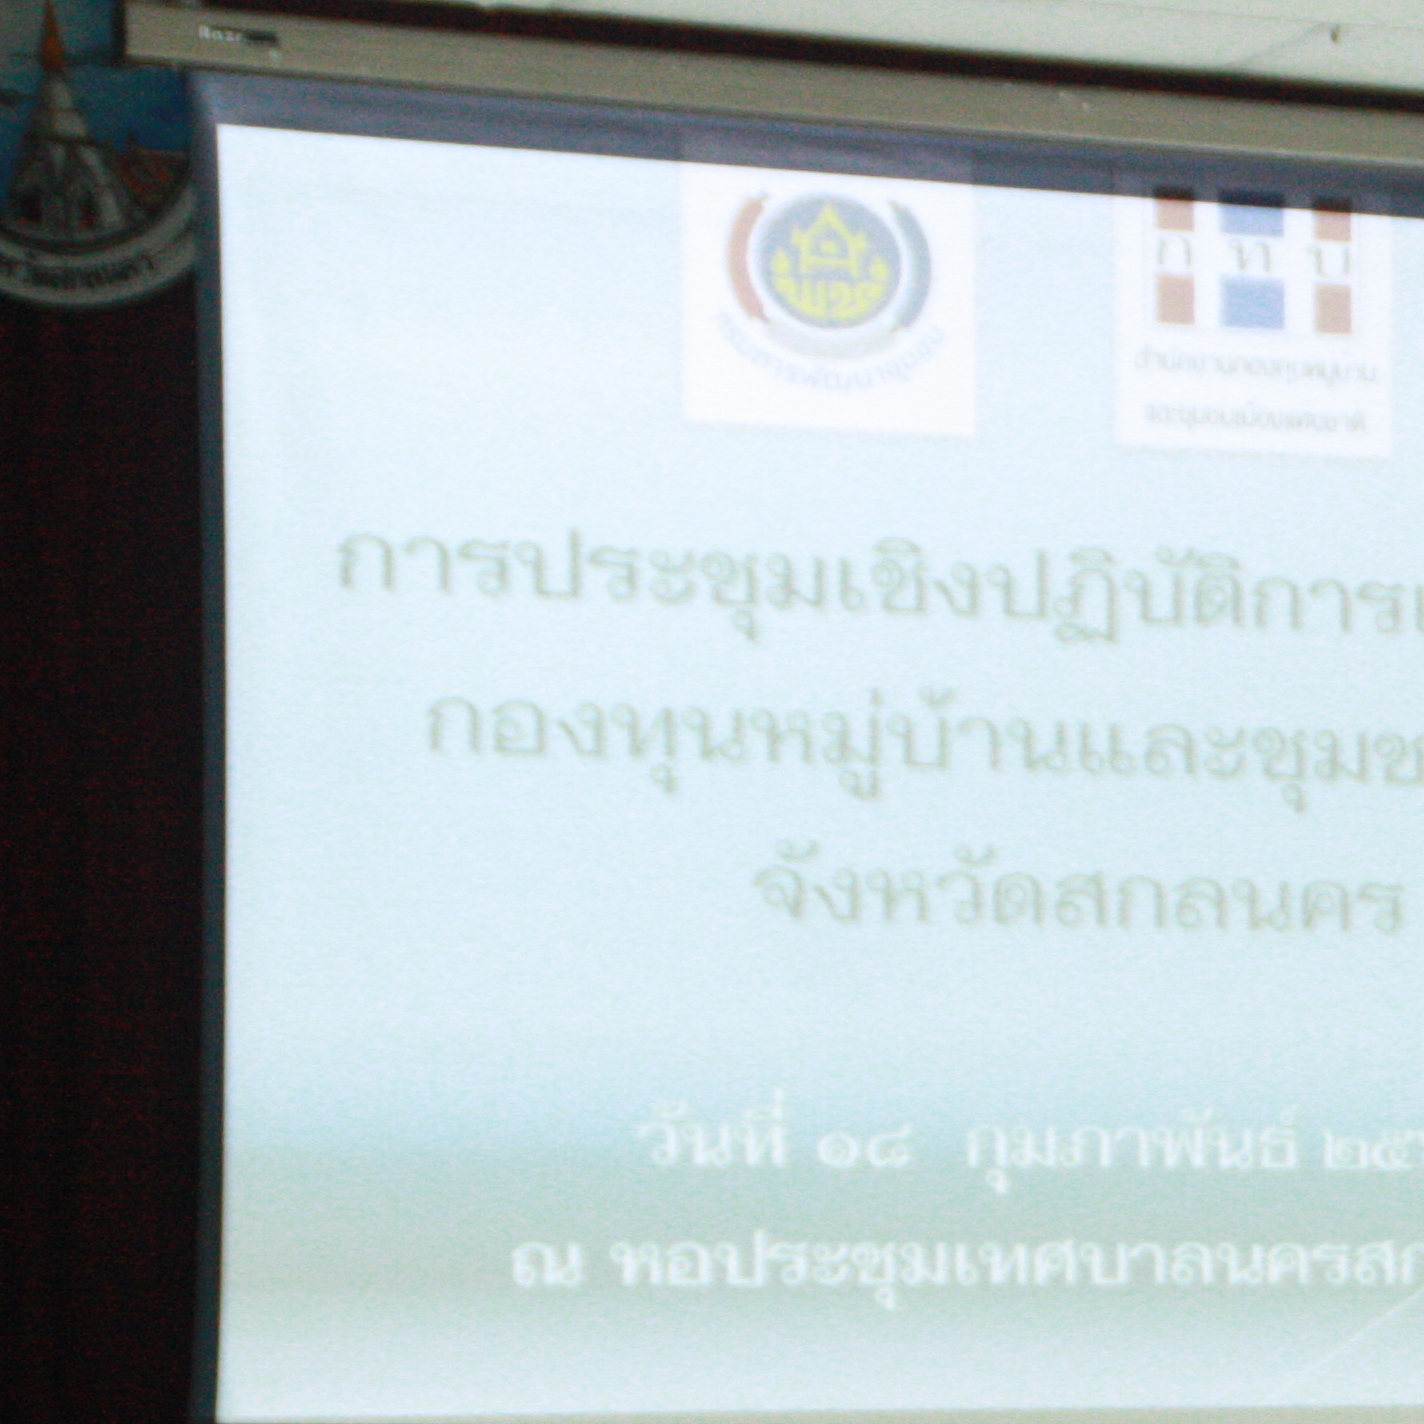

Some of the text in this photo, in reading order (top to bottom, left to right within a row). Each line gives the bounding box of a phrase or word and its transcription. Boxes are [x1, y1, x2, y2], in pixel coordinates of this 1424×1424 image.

[752, 838, 1404, 936] จังหวัดสกลนคร
[637, 1089, 789, 1168] วันที่
[817, 1124, 913, 1168] ๑๘
[966, 1106, 1300, 1195] กุมภาพันธ์
[512, 1241, 583, 1287] ณ
